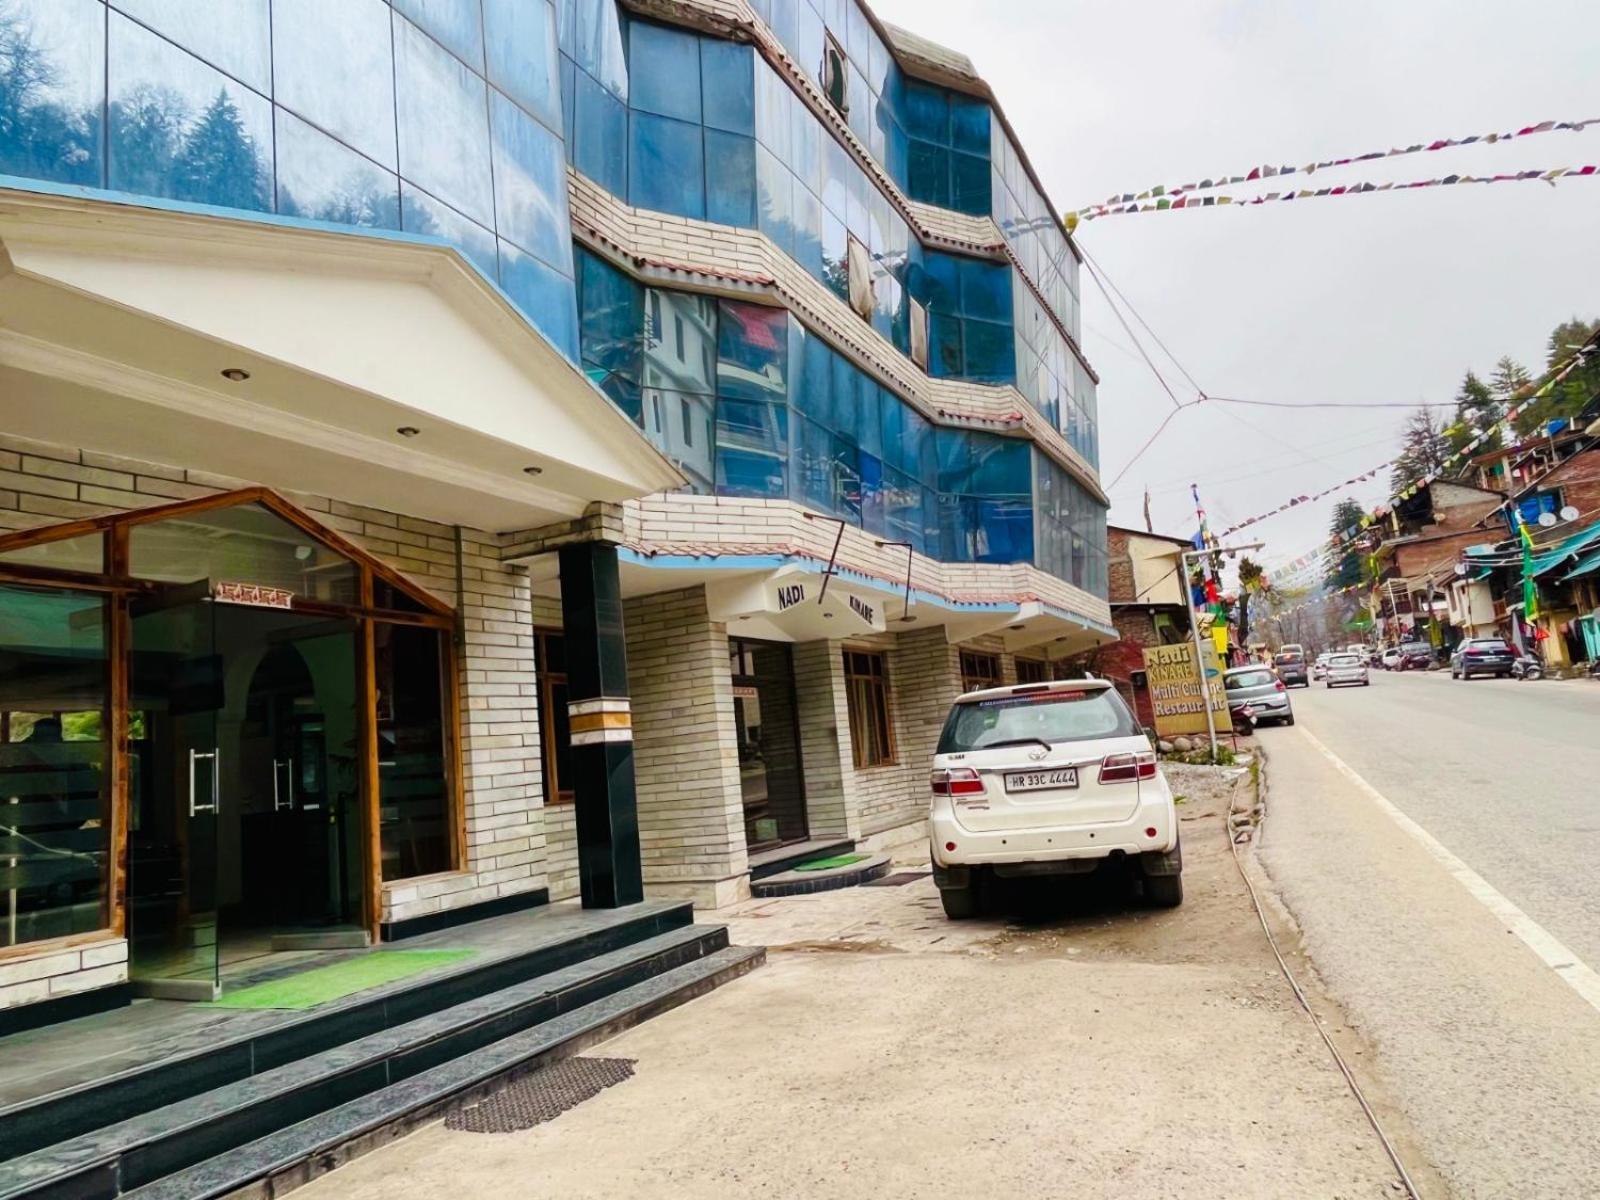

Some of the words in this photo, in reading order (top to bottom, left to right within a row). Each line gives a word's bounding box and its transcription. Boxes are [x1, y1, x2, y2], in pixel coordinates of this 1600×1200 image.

[778, 584, 805, 610] NADI
[850, 595, 873, 625] KINARE
[1146, 646, 1191, 667] Nadi
[1149, 665, 1191, 682] KINARE
[1152, 684, 1180, 699] Multi
[1012, 775, 1025, 787] HR
[1027, 773, 1047, 786] 33C
[1049, 771, 1075, 785] 4444
